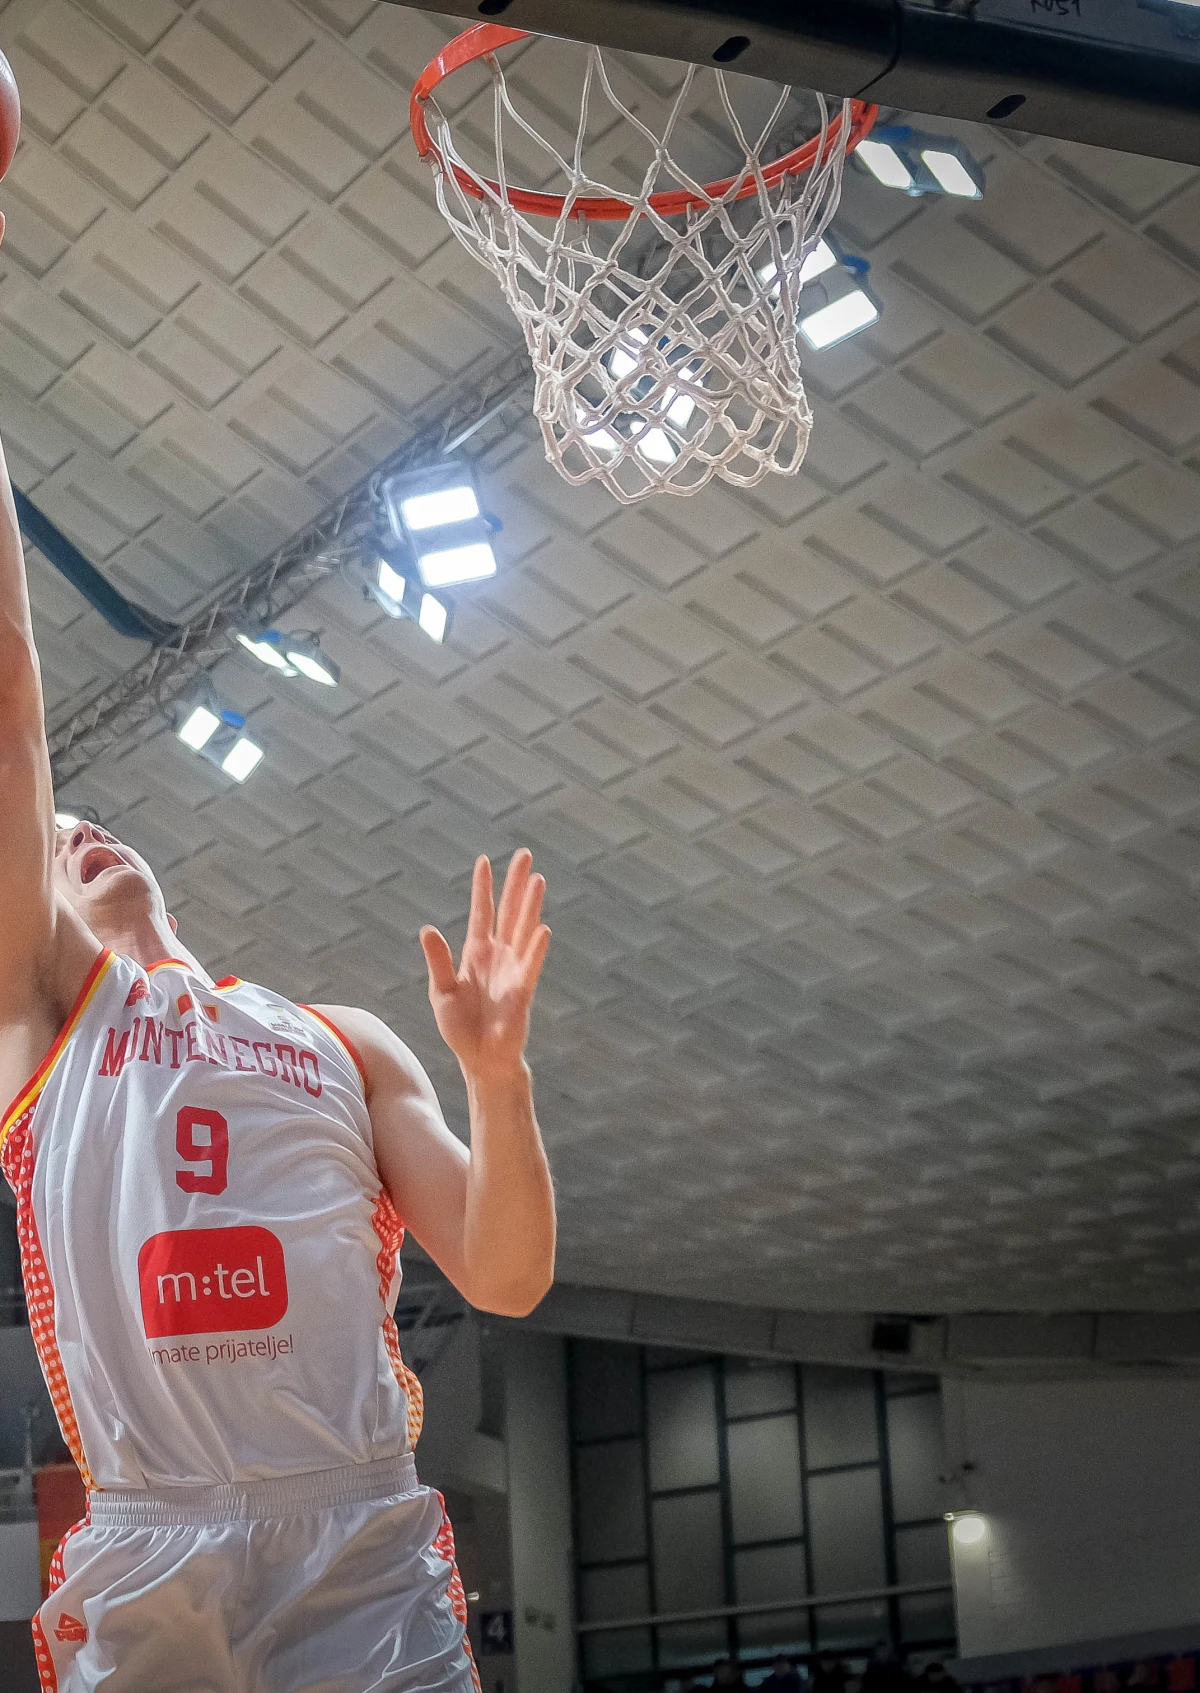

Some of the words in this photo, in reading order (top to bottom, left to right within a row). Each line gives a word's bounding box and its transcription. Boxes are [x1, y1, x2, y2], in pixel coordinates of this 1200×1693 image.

[98, 1016, 323, 1099] MONTENEGRO
[175, 1105, 229, 1195] 9
[157, 1255, 271, 1304] m:tel
[205, 1333, 295, 1365] prijatelje!
